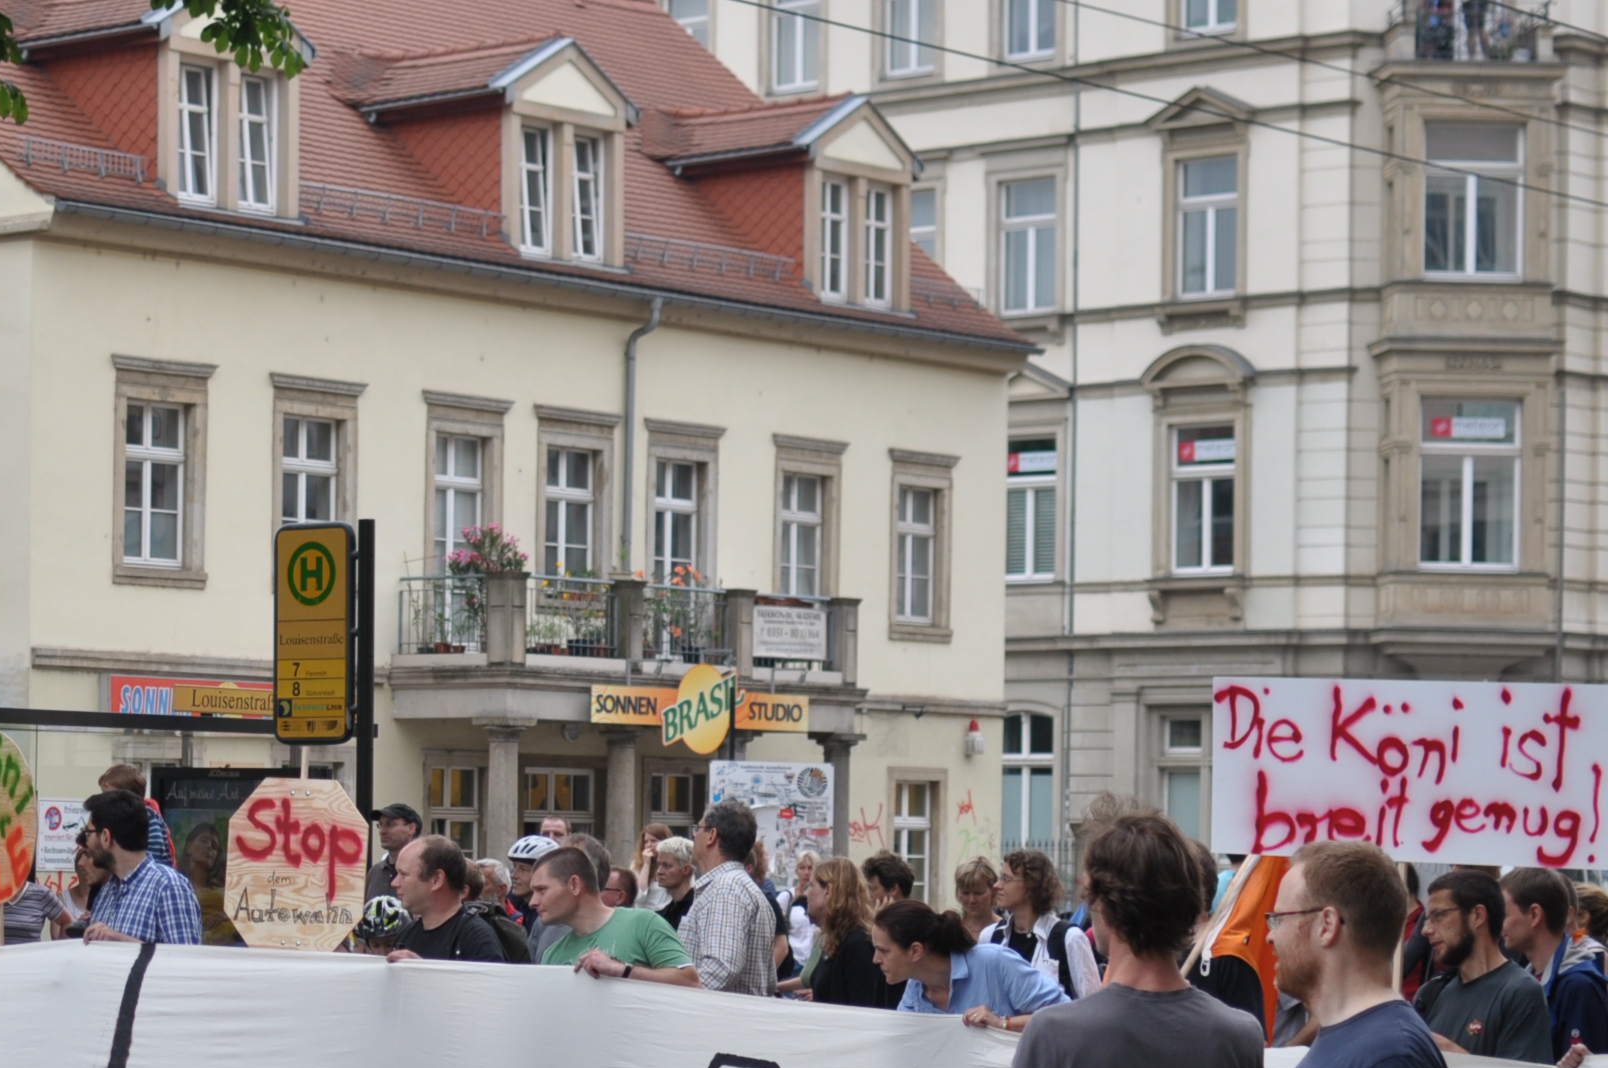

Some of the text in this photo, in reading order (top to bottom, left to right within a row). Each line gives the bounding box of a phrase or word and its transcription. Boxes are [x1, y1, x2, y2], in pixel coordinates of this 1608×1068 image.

[300, 556, 323, 591] H
[279, 633, 344, 646] Louisenstraße
[292, 662, 300, 677] 7
[120, 685, 173, 715] SONN
[293, 681, 300, 696] 8
[596, 694, 658, 716] SONNEN
[664, 675, 745, 743] BRASIL
[748, 701, 803, 722] STUDIO
[1214, 685, 1581, 792] Die Köni ist
[208, 769, 240, 777] JCDecaux
[1251, 763, 1602, 867] breit genug!
[236, 797, 363, 904] Stop
[267, 871, 292, 885] dem
[233, 886, 353, 924] Autowahn
